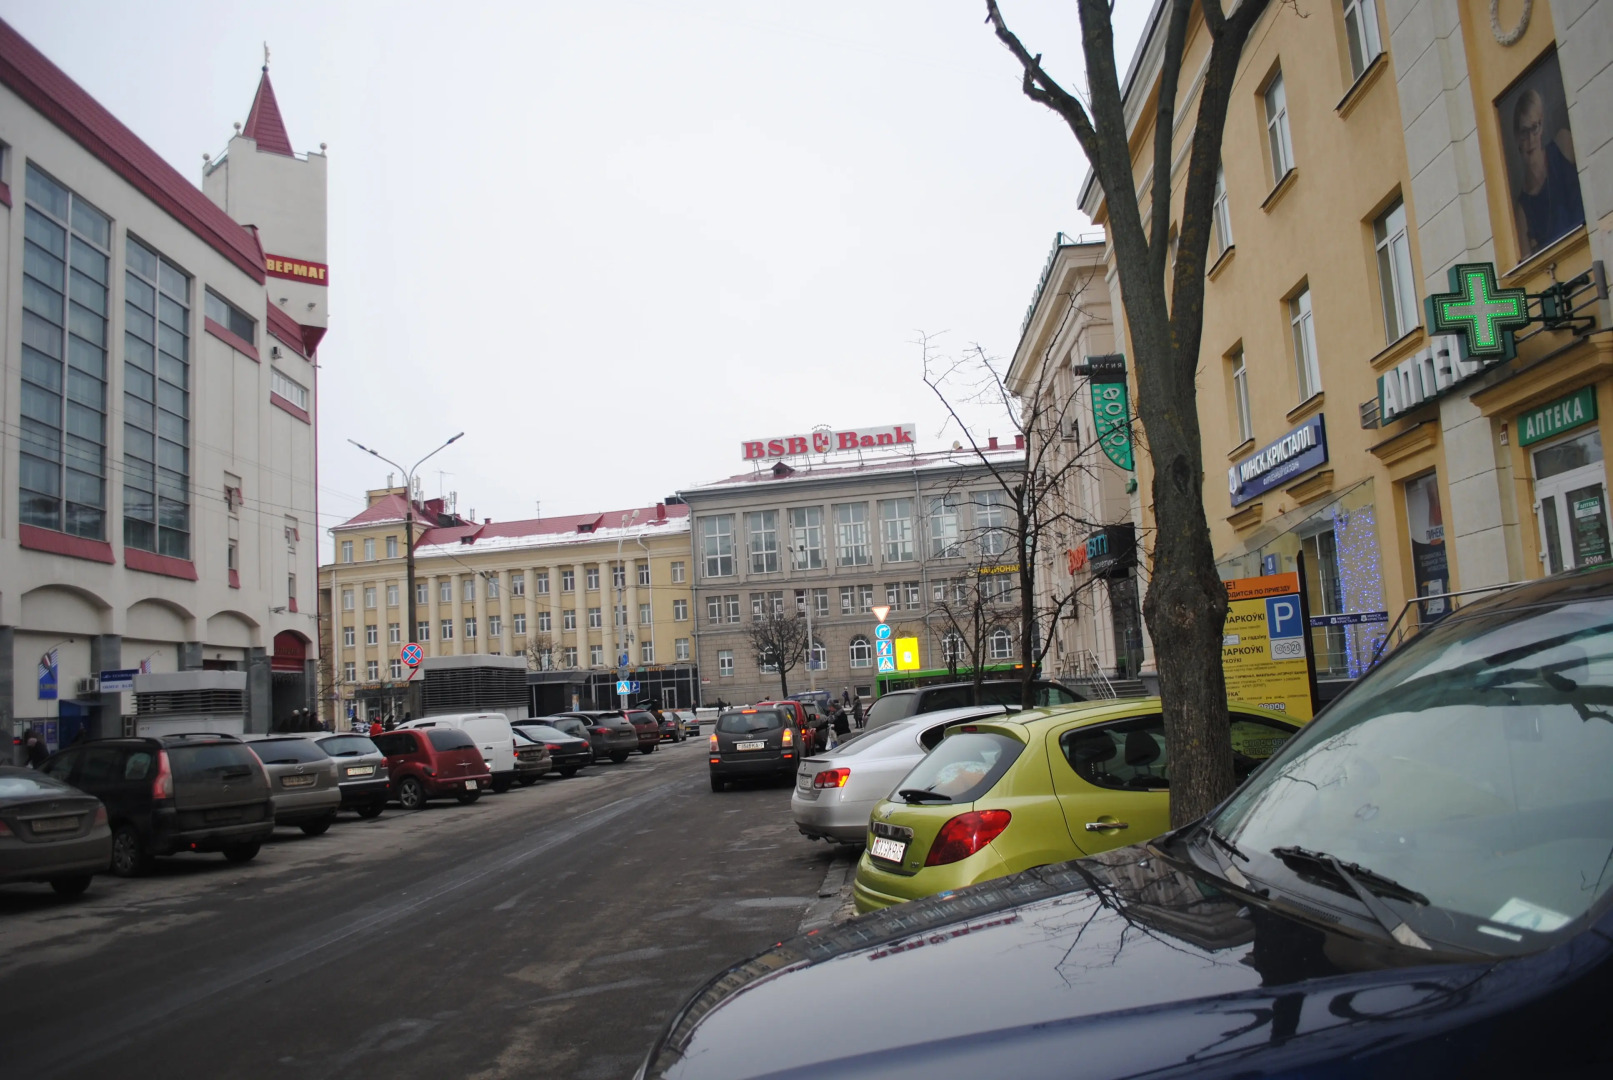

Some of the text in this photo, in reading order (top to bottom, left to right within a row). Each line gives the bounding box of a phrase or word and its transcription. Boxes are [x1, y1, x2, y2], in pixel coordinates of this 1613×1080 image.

[266, 259, 325, 279] ВЕРМАГ
[1383, 334, 1498, 419] АПТЕК
[1102, 387, 1127, 446] ФОТО
[1526, 397, 1584, 440] АПТЕКА
[743, 427, 912, 460] BSB Bank
[1240, 425, 1313, 482] МИНСК КРИСТАЛЛ
[1265, 585, 1290, 593] ПРИЕЗДУ
[1273, 602, 1294, 633] P
